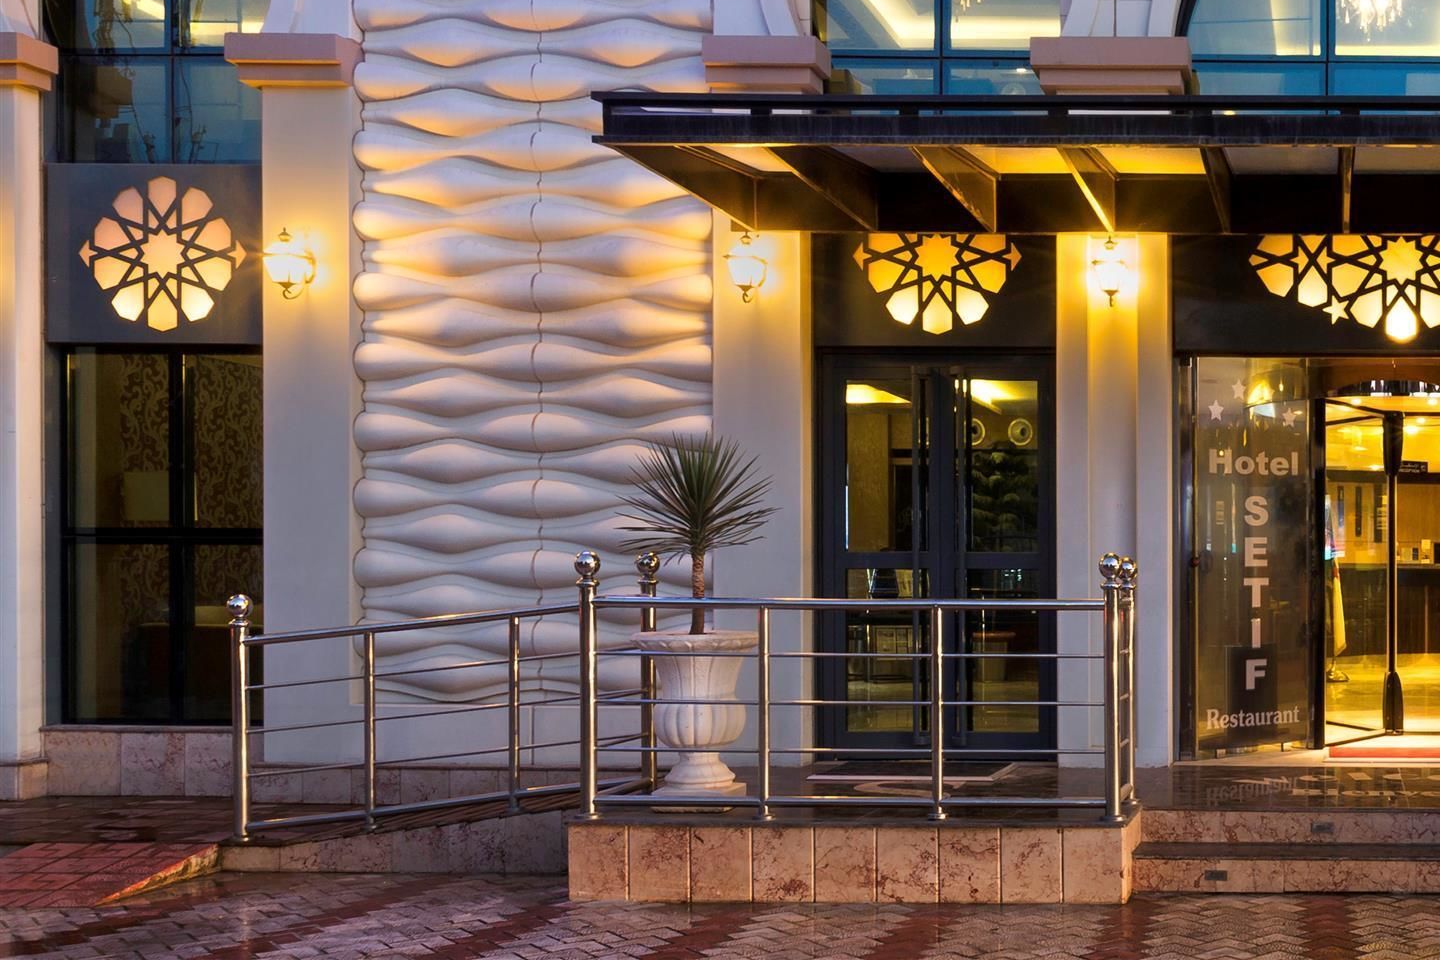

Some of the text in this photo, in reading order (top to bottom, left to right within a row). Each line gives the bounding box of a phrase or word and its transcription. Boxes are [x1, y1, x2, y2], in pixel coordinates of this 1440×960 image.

[1208, 448, 1299, 476] Hotel
[1243, 495, 1270, 690] SETIF
[1206, 705, 1300, 730] Restaurant
